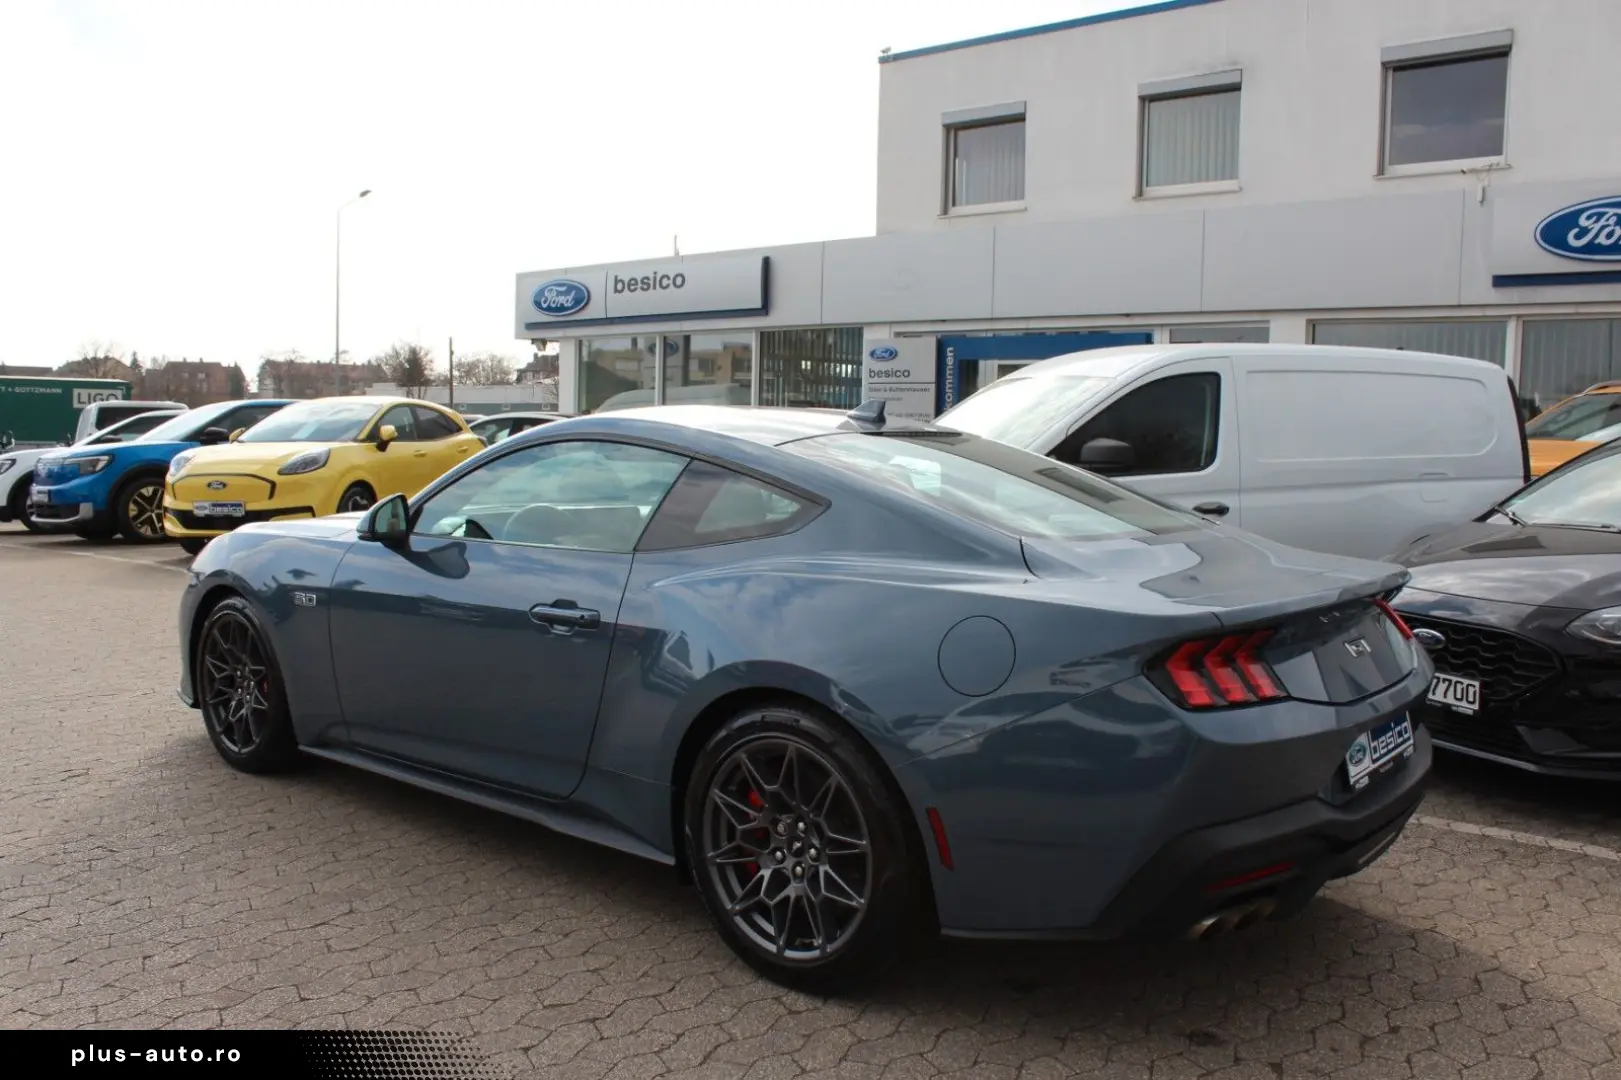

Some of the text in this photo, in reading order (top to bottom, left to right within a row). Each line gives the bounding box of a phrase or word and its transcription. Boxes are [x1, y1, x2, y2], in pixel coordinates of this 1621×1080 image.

[613, 271, 685, 294] besico
[541, 286, 574, 308] Ford
[868, 368, 911, 378] besico
[1431, 677, 1477, 705] 7700
[1369, 721, 1410, 760] besico
